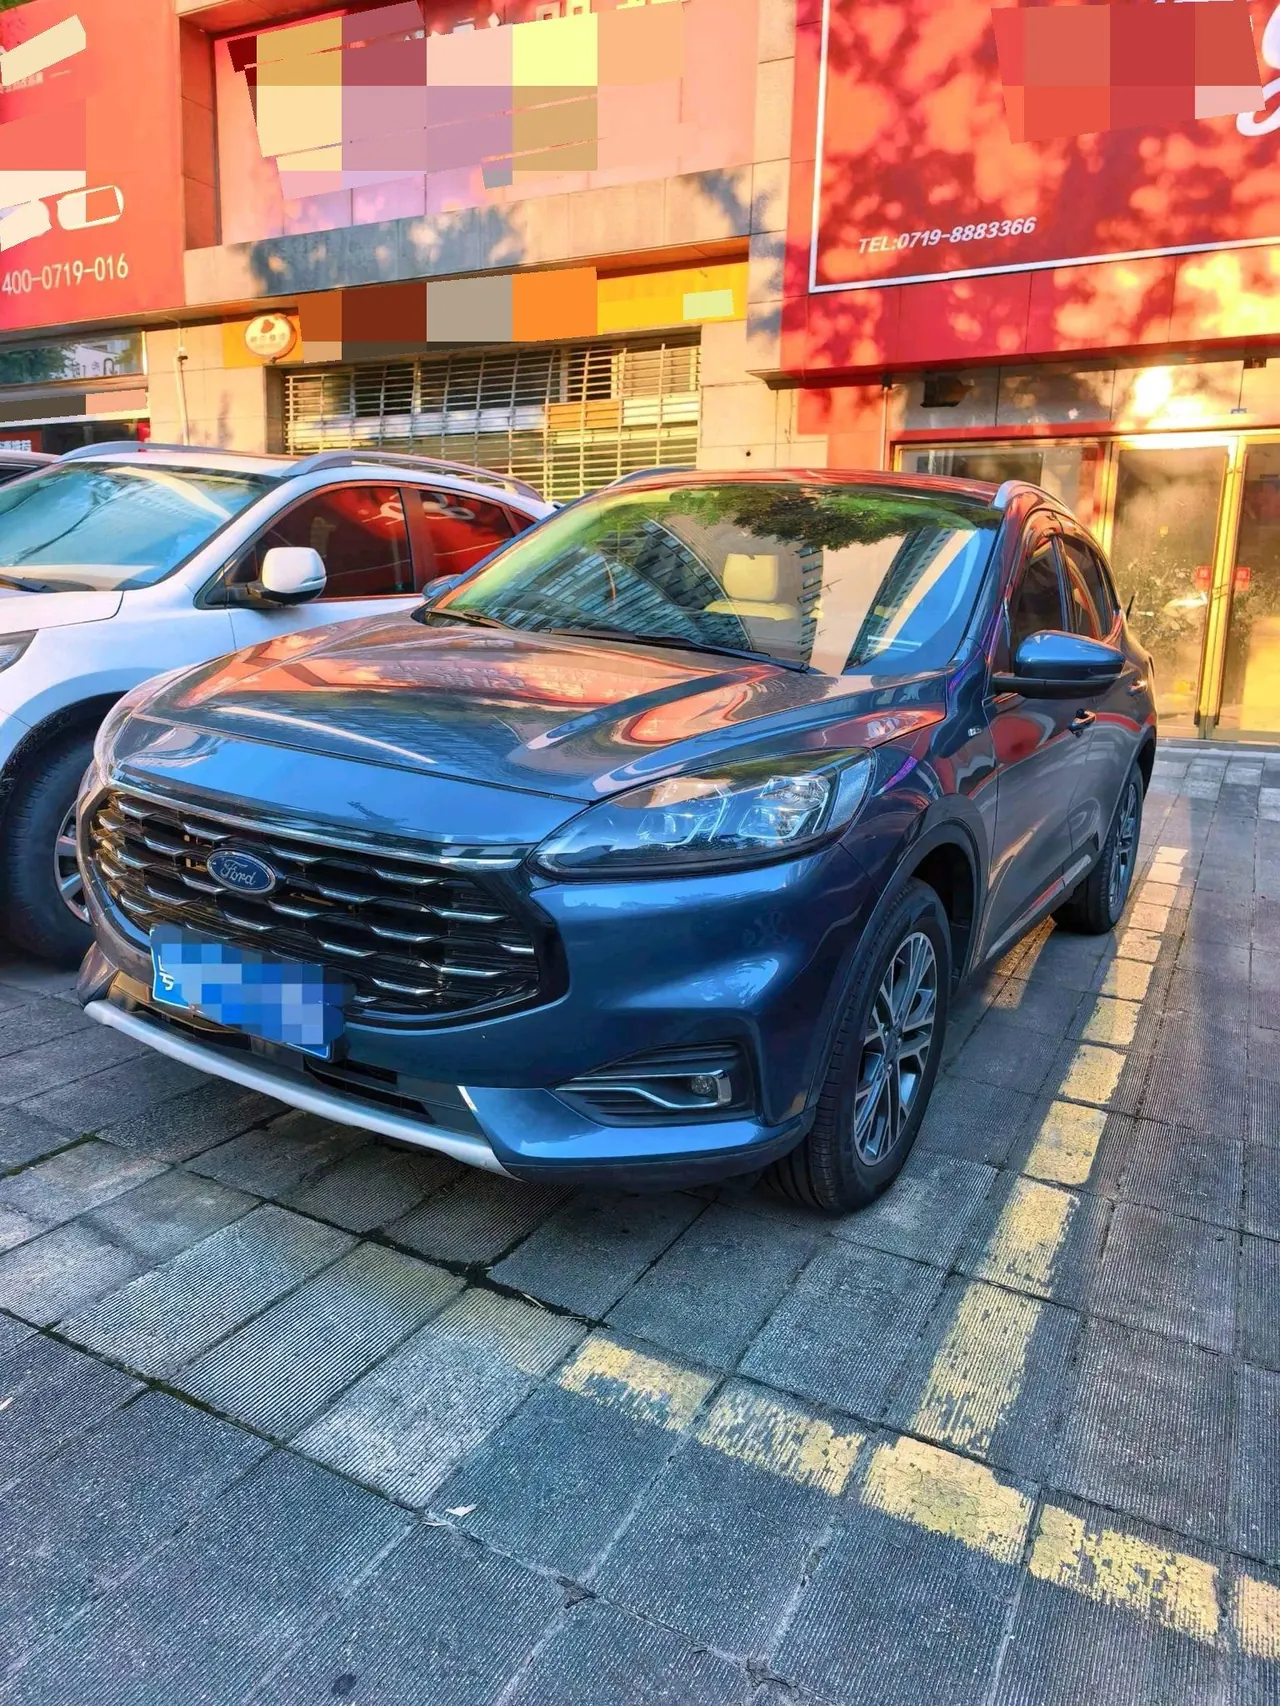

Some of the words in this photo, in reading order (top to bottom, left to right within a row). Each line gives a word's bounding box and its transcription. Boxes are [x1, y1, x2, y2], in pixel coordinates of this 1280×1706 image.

[859, 216, 1037, 254] TEL:0719-8883366
[2, 253, 129, 295] 400-0719-016
[220, 859, 257, 885] Ford
